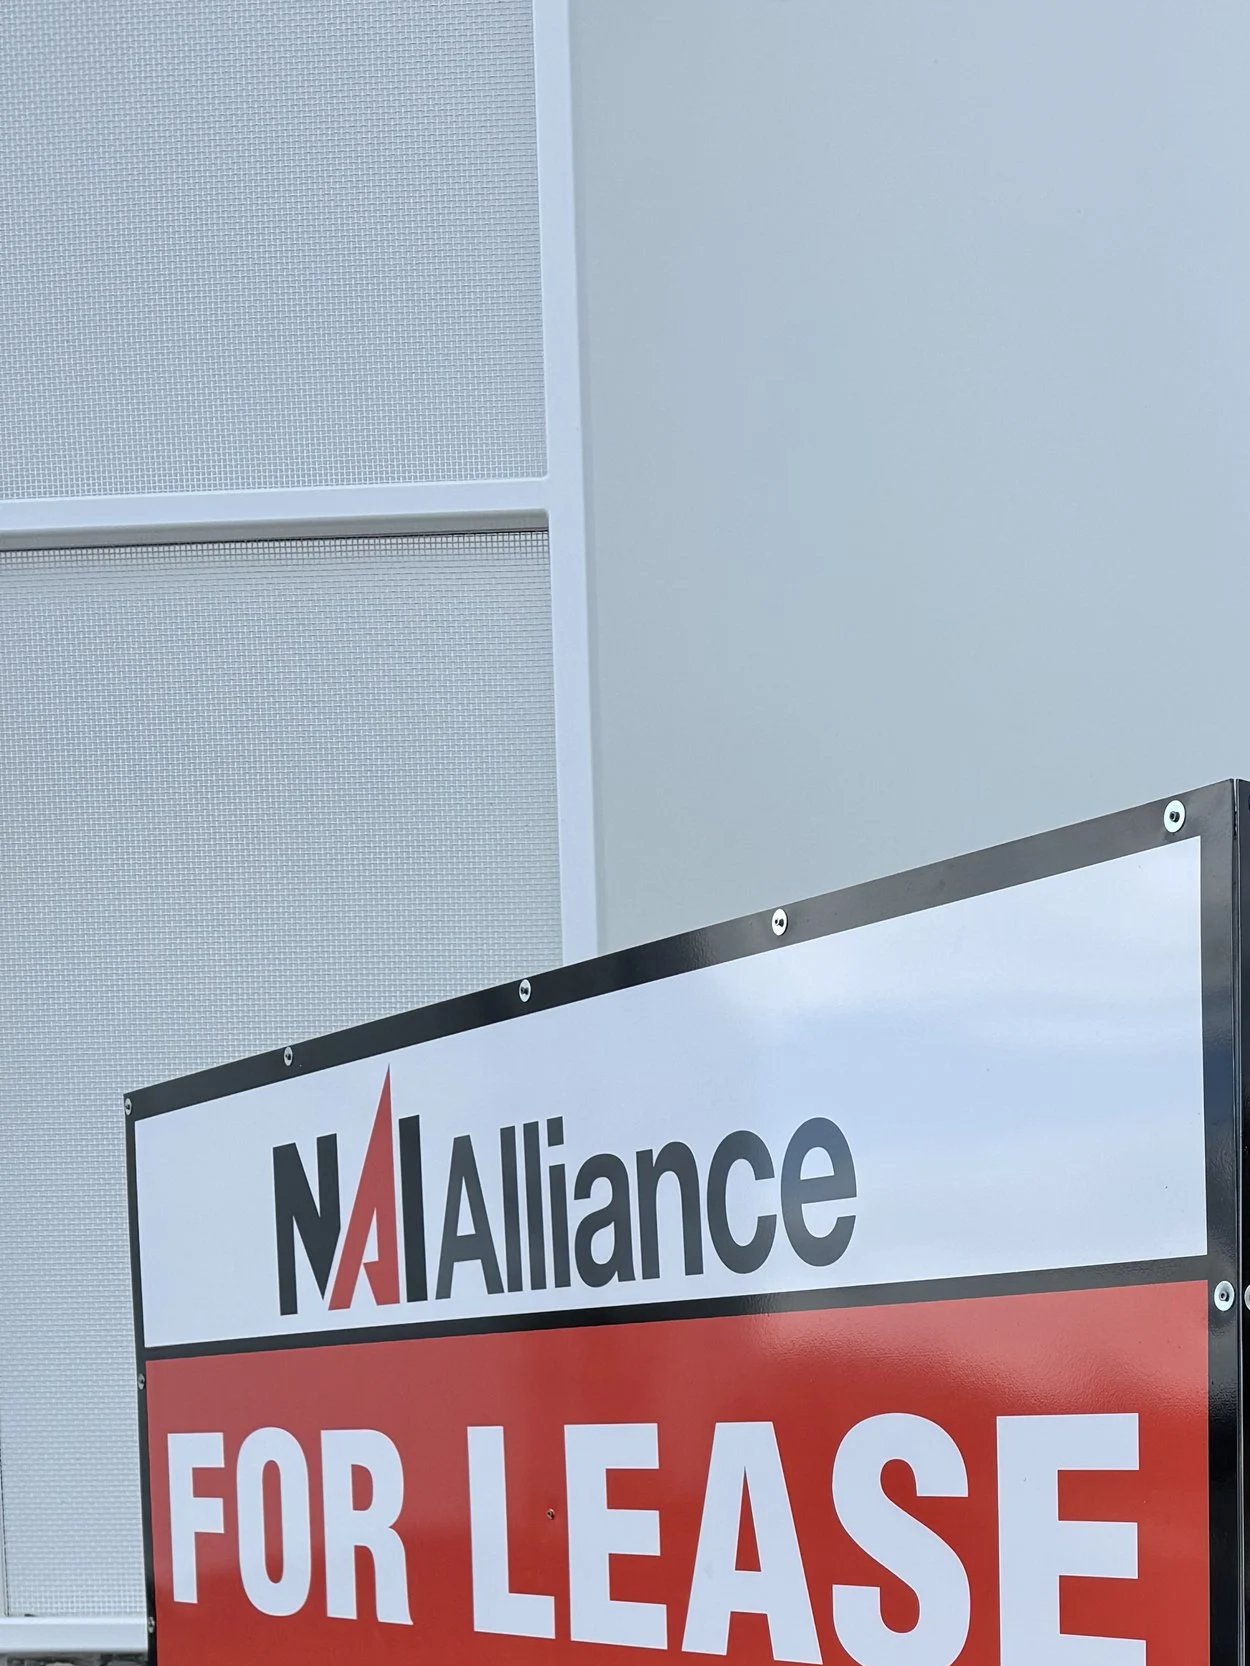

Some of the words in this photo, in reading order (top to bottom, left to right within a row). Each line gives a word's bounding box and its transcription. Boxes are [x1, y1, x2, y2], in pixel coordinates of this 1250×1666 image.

[273, 1064, 428, 1316] NAI
[436, 1116, 856, 1300] Alliance
[168, 1427, 413, 1629] FOR
